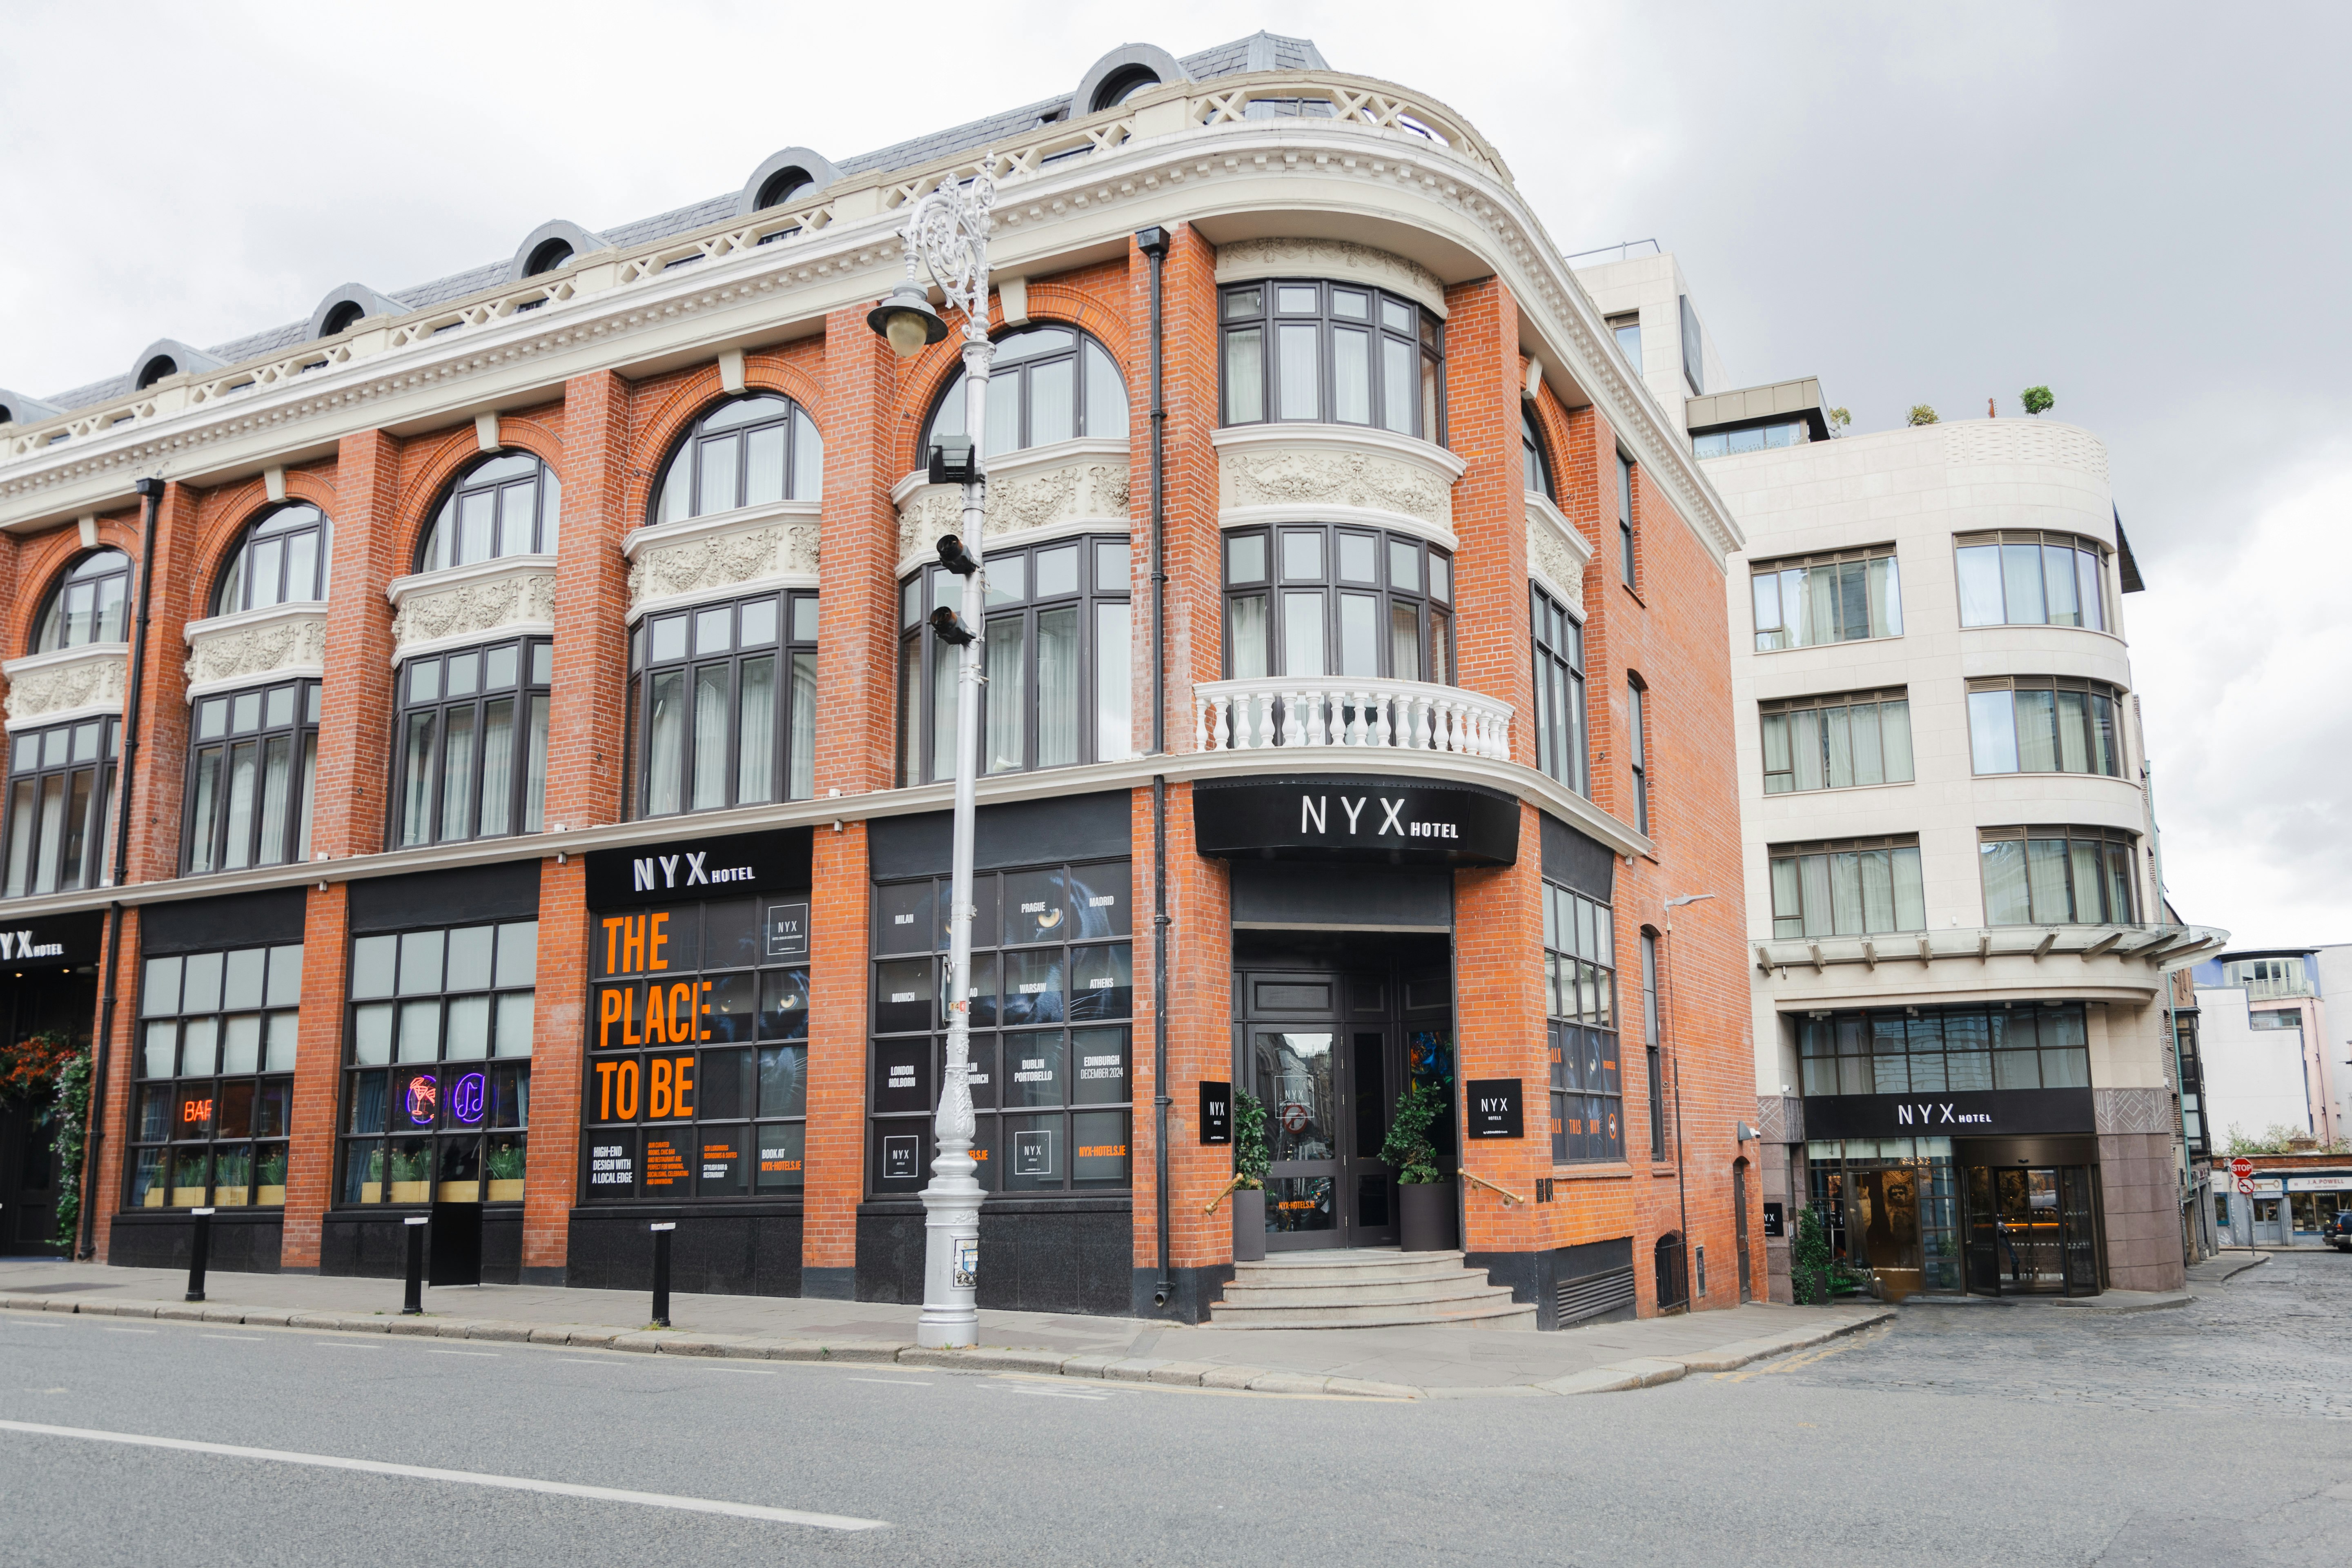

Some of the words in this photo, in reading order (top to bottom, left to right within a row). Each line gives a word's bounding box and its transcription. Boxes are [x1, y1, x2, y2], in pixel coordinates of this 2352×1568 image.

[1302, 795, 1405, 836] NYX
[1410, 822, 1459, 838] HOTEL
[634, 851, 708, 891] NYX
[712, 866, 755, 883] HOTEL
[1089, 895, 1114, 907] MADRID
[1021, 902, 1045, 913] PRAGUE
[895, 913, 914, 924] MILAN
[778, 920, 797, 933] NYX
[0, 930, 33, 960] YX
[33, 943, 64, 957] HOTEL
[603, 912, 669, 974] THE
[1019, 982, 1047, 993] WARSAW
[1089, 978, 1114, 989] ATHENS
[891, 991, 915, 1003] MUNICH
[600, 982, 712, 1047] PLACE
[1084, 1055, 1120, 1067] EDINBURGH
[1551, 1047, 1562, 1063] ALK
[890, 1065, 914, 1076] LONDON
[1022, 1059, 1045, 1070] DUBLIN
[1014, 1070, 1053, 1082] PORTOBELLO
[1080, 1068, 1109, 1079] DECEMBER
[1109, 1067, 1123, 1078] 2024
[889, 1077, 915, 1088] HOLBORN
[596, 1060, 639, 1120] TO
[650, 1058, 694, 1118] BE
[1285, 1090, 1304, 1099] NYX
[1210, 1102, 1224, 1116] NYX
[1481, 1098, 1508, 1112] NYX
[1898, 1103, 1955, 1125] NYX
[1958, 1114, 1992, 1123] HOTEL
[1552, 1118, 1562, 1134] ALK
[1569, 1119, 1581, 1134] THIS
[593, 1146, 623, 1157] HIGH-END
[762, 1149, 777, 1159] BOOK
[777, 1148, 785, 1158] AT
[893, 1149, 909, 1160] NYX
[1024, 1145, 1042, 1156] NYX
[1079, 1145, 1125, 1157] NYX-HOTELS.IE
[593, 1159, 615, 1171] DESIGN
[615, 1159, 631, 1170] WITH
[761, 1160, 802, 1171] NYX-HOTELS.IE
[592, 1173, 597, 1184] A
[597, 1172, 616, 1184] LOCAL
[617, 1172, 633, 1183] EDGE
[1278, 1200, 1315, 1210] NYX-HOTELS.IE
